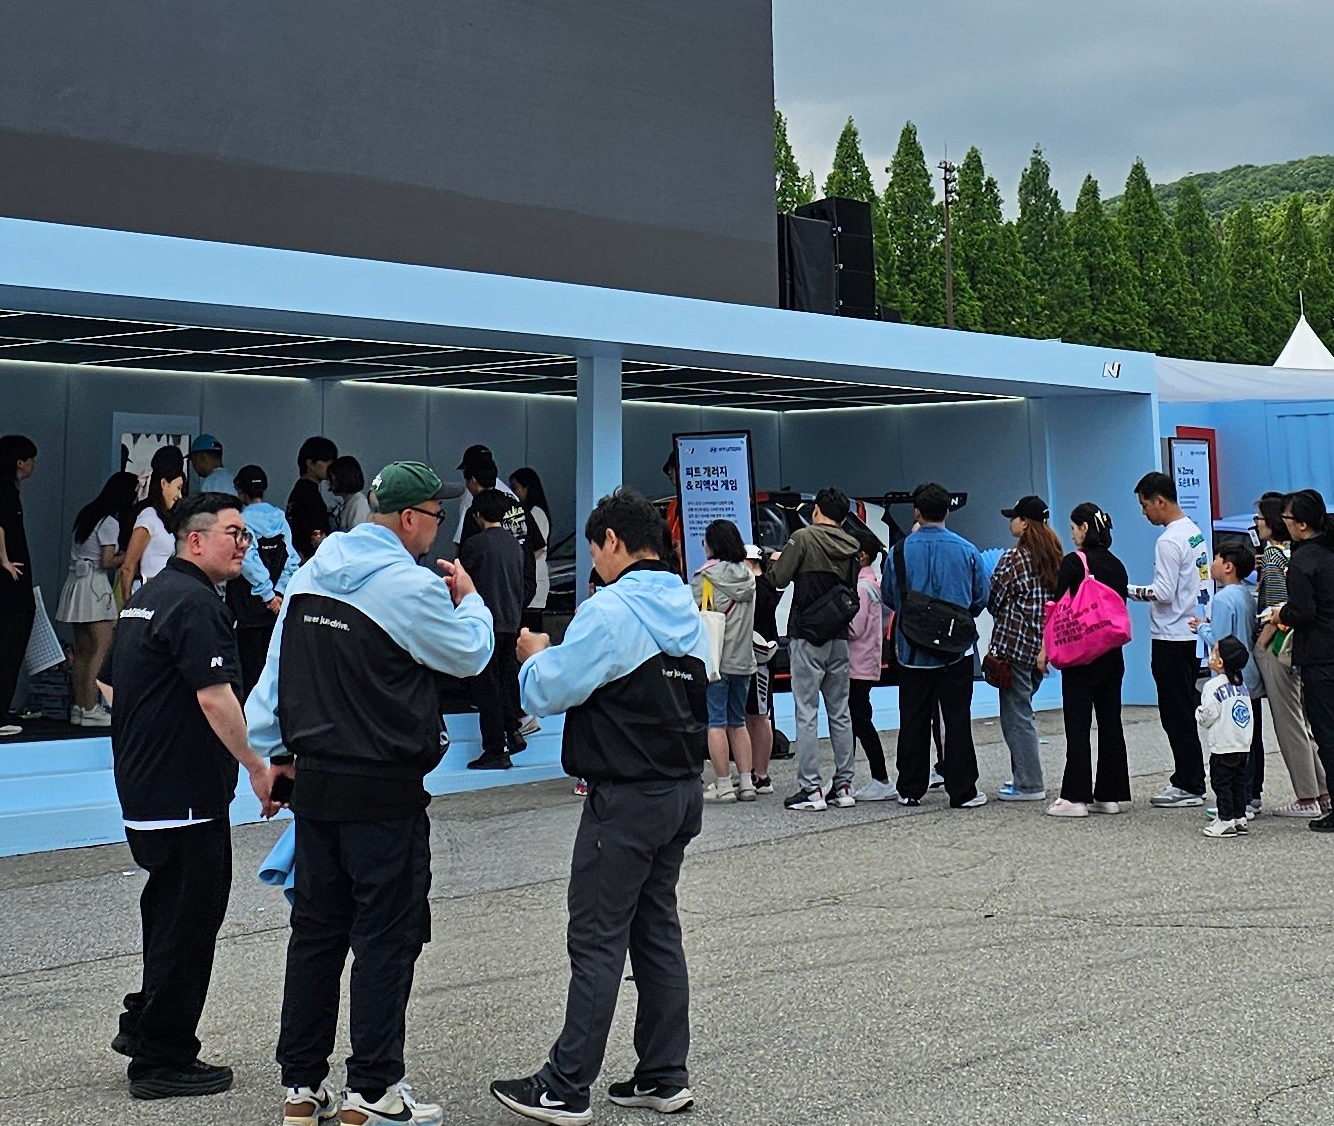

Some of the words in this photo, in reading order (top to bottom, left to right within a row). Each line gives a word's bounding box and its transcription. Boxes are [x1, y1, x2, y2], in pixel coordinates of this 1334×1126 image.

[685, 466, 702, 478] 피트
[686, 480, 694, 491] &
[695, 479, 719, 491] 리액션
[721, 479, 738, 491] 게임
[950, 496, 959, 506] N
[210, 656, 224, 668] N
